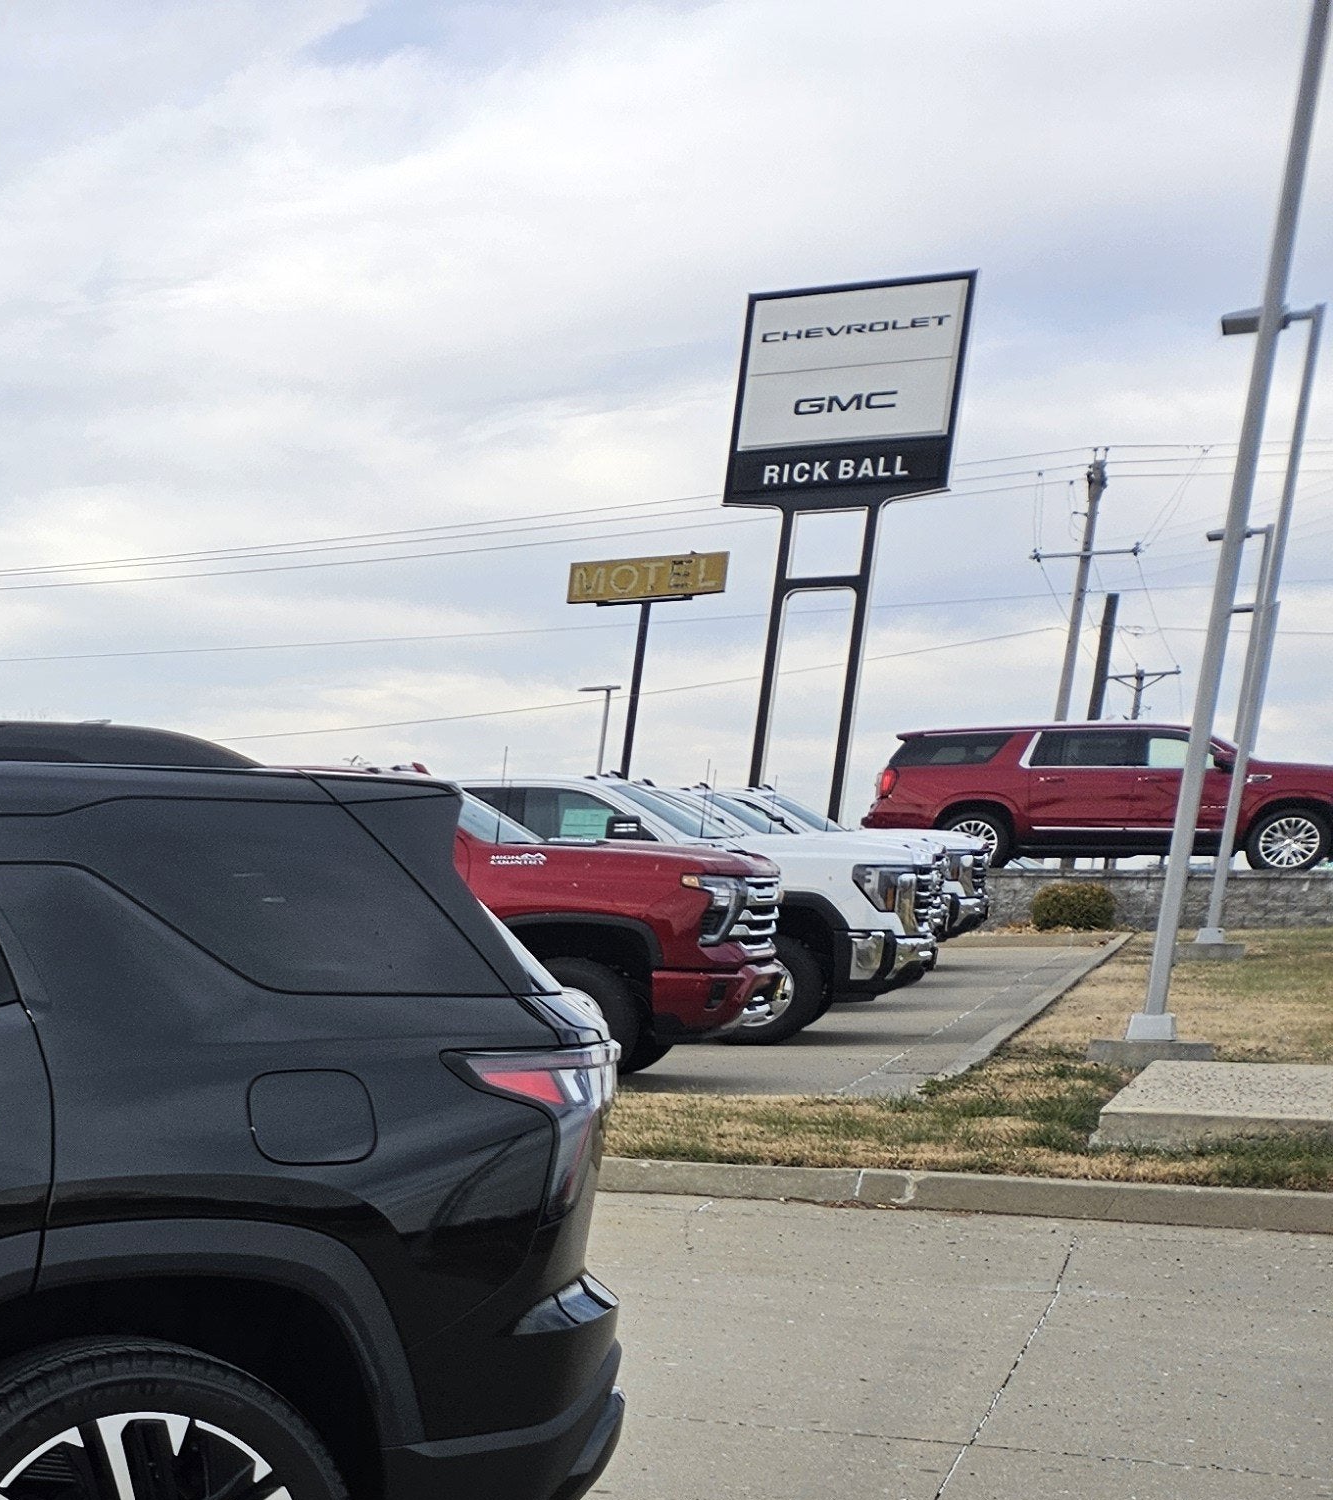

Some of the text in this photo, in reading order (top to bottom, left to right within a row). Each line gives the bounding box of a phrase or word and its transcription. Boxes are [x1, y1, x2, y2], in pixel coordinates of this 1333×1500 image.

[761, 314, 951, 343] CHEVROLET
[793, 390, 899, 416] GMC
[763, 454, 909, 485] RICK BALL
[572, 557, 717, 596] MOTEL
